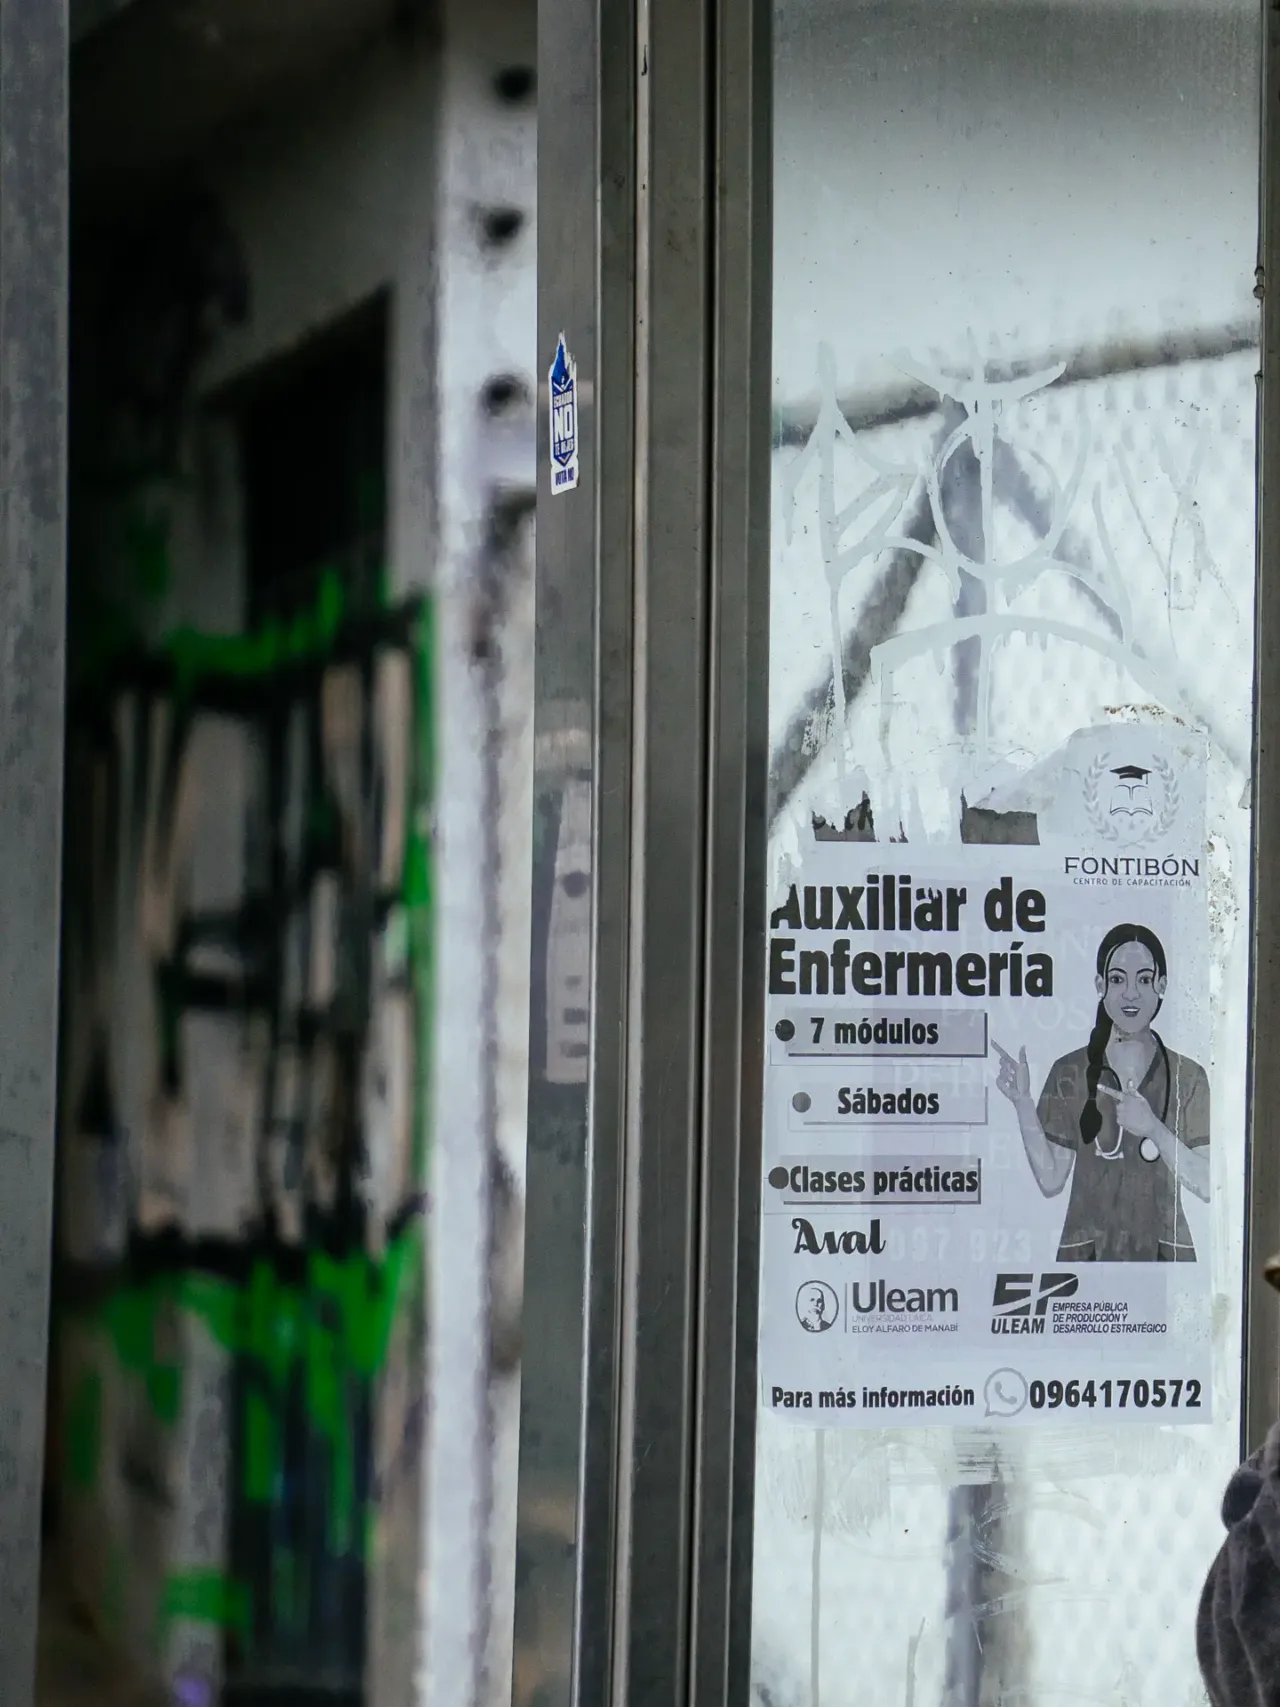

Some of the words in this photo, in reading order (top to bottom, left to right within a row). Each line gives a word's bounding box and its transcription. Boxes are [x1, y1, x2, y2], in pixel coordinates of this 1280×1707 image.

[554, 403, 573, 443] NO
[1064, 853, 1200, 877] FONTIBÓN
[1072, 877, 1109, 887] CENTRO
[1111, 878, 1123, 887] DE
[1126, 878, 1192, 888] CAPACITACIÓN
[769, 873, 967, 932] Auxiliar
[983, 876, 1046, 933] de
[768, 937, 1053, 998] Enfermería
[810, 1017, 825, 1044] 7
[834, 1017, 939, 1045] módulos
[837, 1087, 940, 1115] Sábados
[790, 1165, 866, 1193] Clases
[872, 1164, 980, 1196] prácticas
[791, 1217, 887, 1255] Aval
[852, 1279, 959, 1314] Uleam
[1052, 1302, 1092, 1312] EMPRESA
[1094, 1301, 1128, 1312] PÚBLICA
[924, 1323, 958, 1332] MANABÍ
[990, 1317, 1046, 1335] ULEAM
[1053, 1313, 1064, 1322] DE
[1066, 1312, 1121, 1323] PRODUCCIÓN
[1122, 1313, 1128, 1322] Y
[1053, 1324, 1109, 1333] DESARROLLO
[1111, 1322, 1167, 1333] ESTRATÉGICO
[771, 1386, 813, 1408] Para
[818, 1386, 857, 1409] más
[862, 1384, 975, 1408] información
[1029, 1379, 1202, 1409] 0964170572
